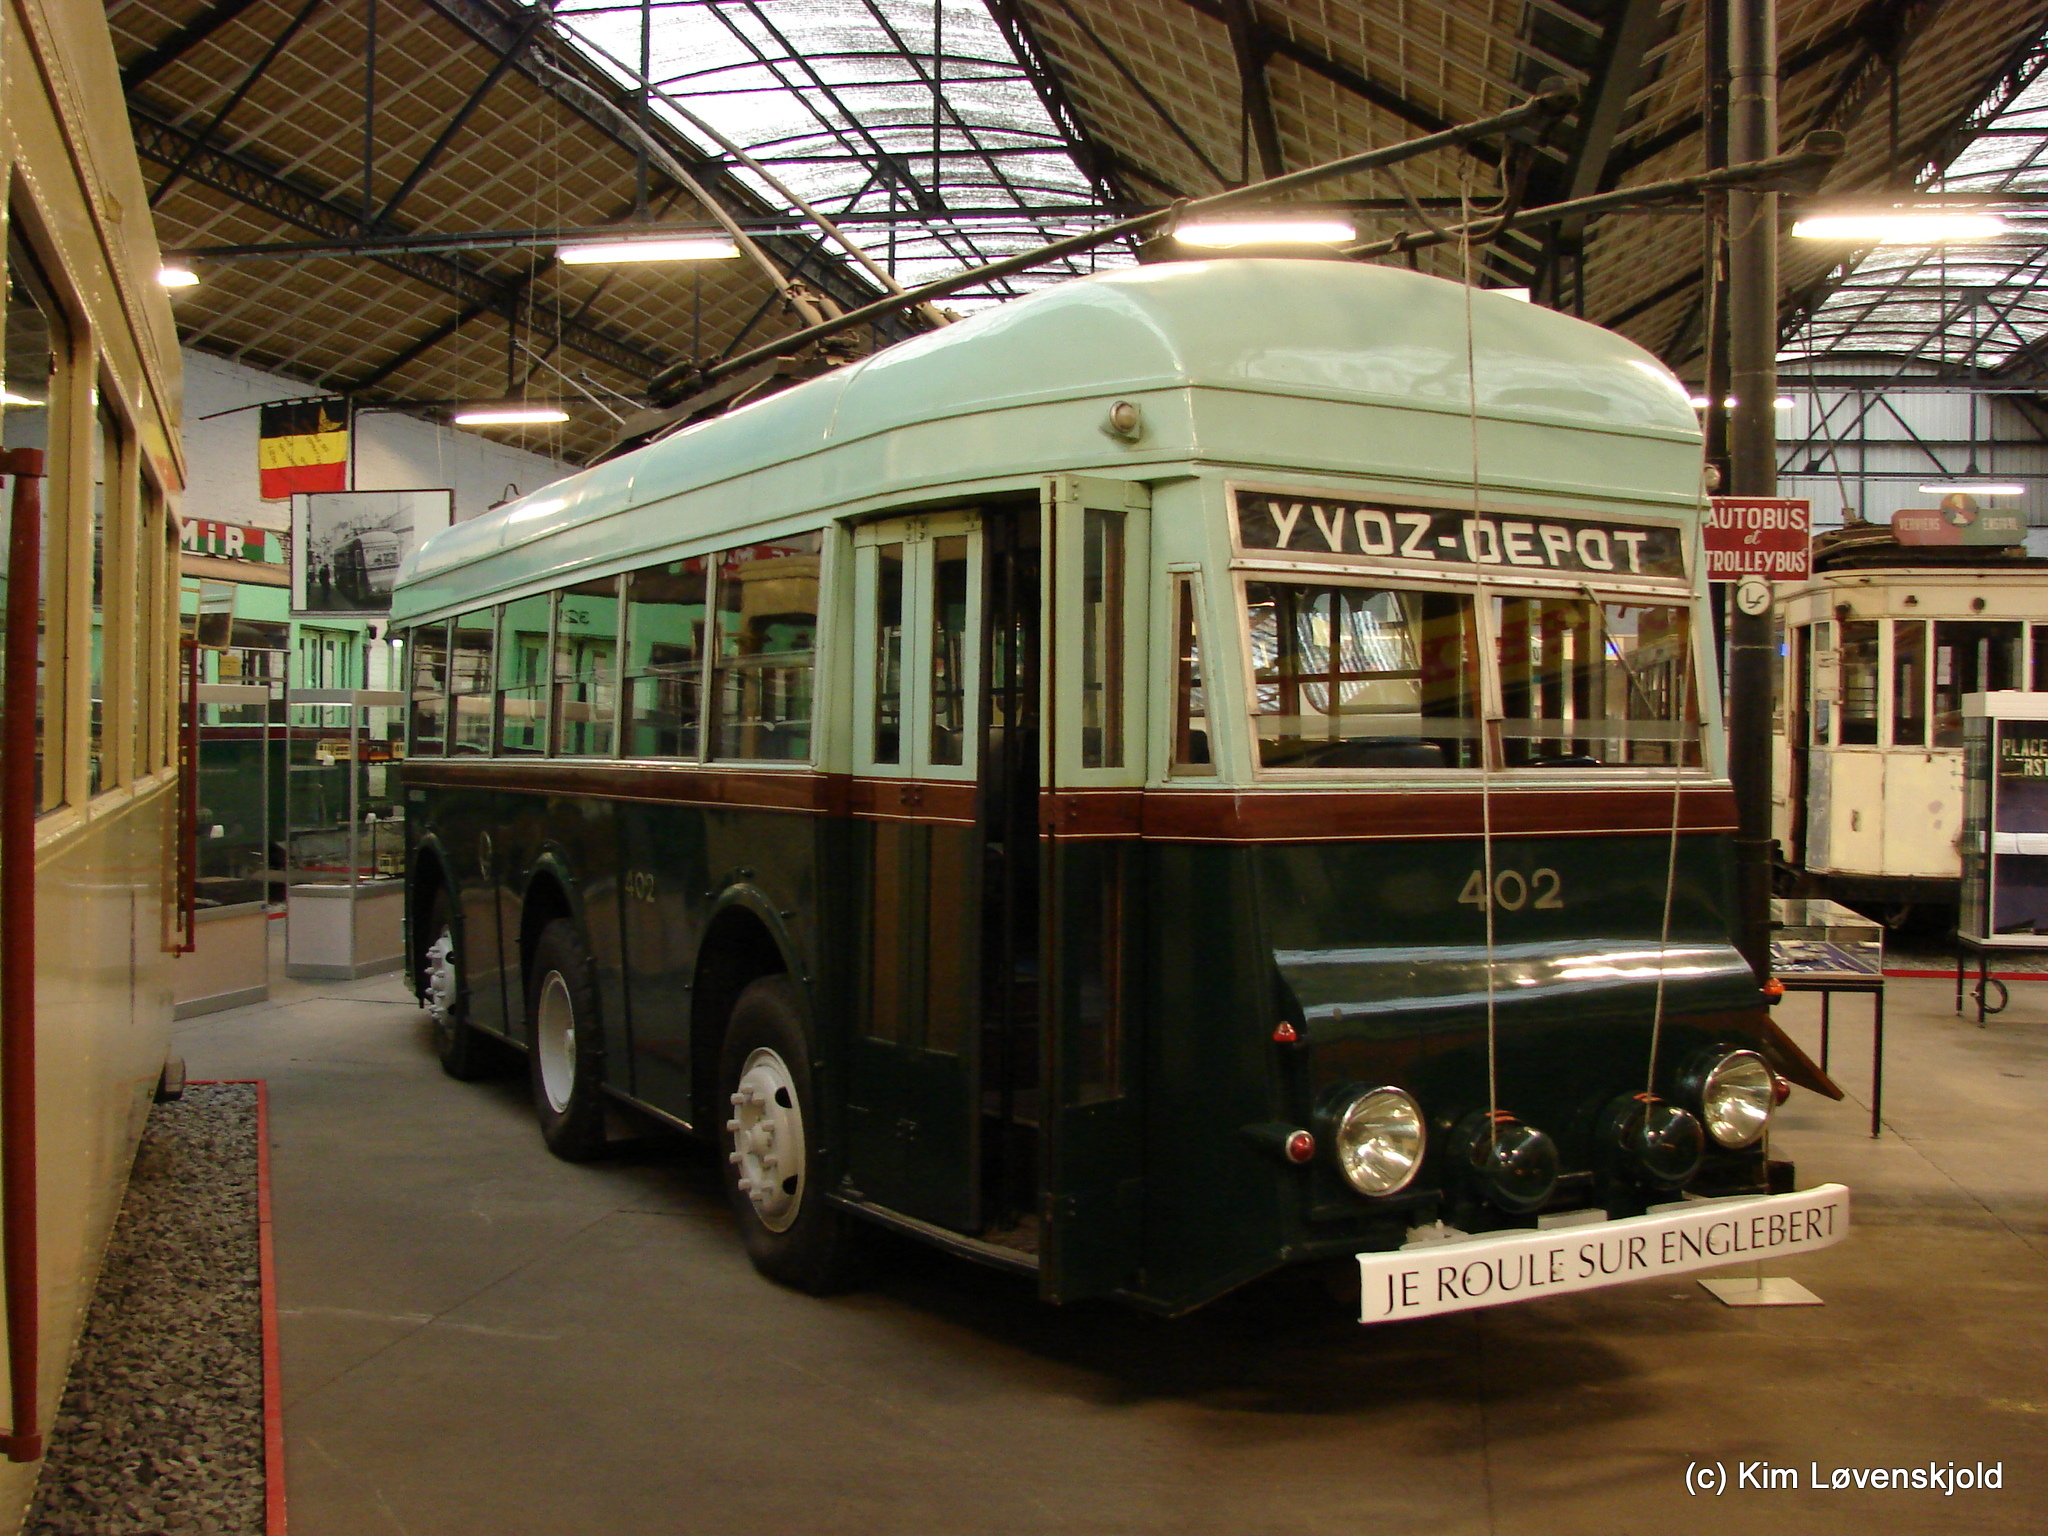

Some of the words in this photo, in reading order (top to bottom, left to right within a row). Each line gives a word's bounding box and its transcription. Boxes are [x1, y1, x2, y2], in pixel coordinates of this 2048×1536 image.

[1704, 507, 1806, 530] AUTOBUS
[1267, 501, 1648, 574] YVOZ-DEPOT
[1743, 529, 1762, 545] et
[1704, 550, 1807, 573] TROLLEYBUS
[2002, 738, 2048, 757] PLACE
[624, 870, 656, 903] 402
[1457, 867, 1565, 912] 402
[1382, 1270, 1421, 1315] JE
[1437, 1248, 1565, 1297] ROULE
[1578, 1236, 1648, 1279] SUR
[1661, 1203, 1838, 1264] ENGLEBERT
